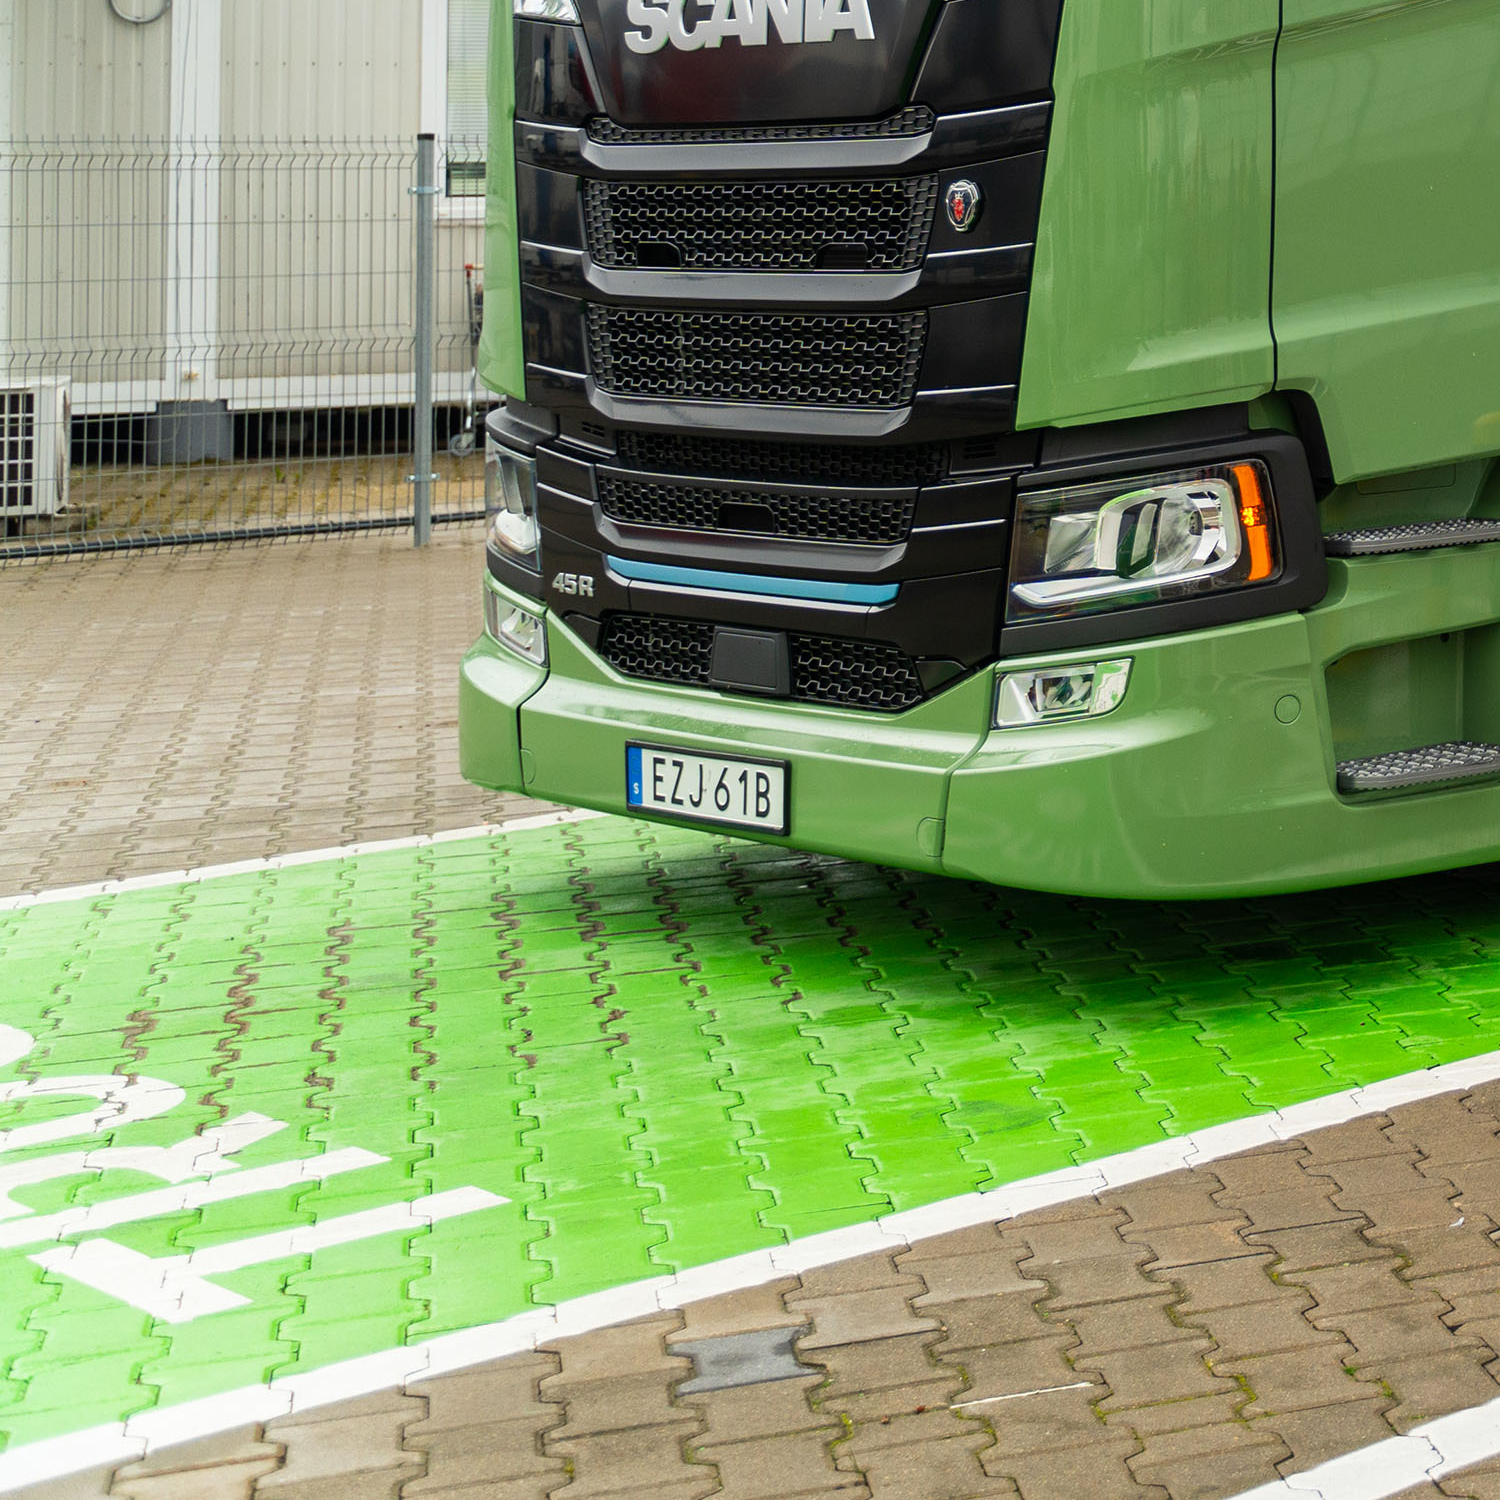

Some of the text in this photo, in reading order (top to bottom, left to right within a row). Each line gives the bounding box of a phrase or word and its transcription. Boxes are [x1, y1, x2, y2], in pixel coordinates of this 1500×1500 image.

[552, 572, 594, 597] 45R
[653, 756, 704, 808] EZJ
[714, 766, 770, 818] 61B
